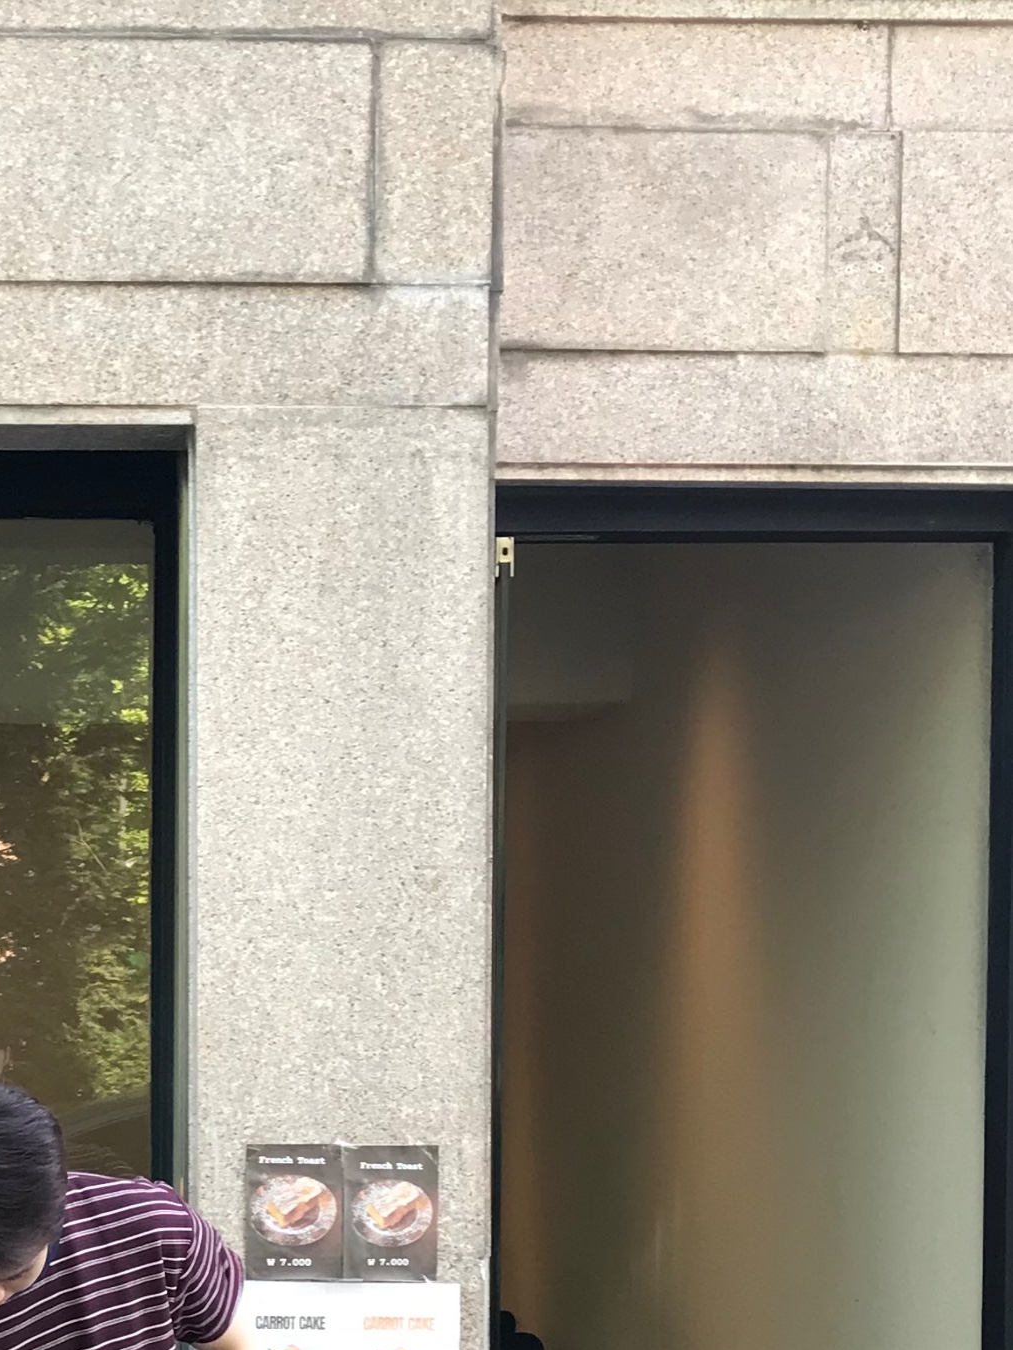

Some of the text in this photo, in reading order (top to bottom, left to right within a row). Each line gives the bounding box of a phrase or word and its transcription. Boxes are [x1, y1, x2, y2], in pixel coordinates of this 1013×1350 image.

[258, 1155, 326, 1165] French Toast
[359, 1161, 424, 1170] French Toast
[255, 1315, 326, 1330] CARROT CAKE
[363, 1316, 436, 1331] CARROT CAKE
